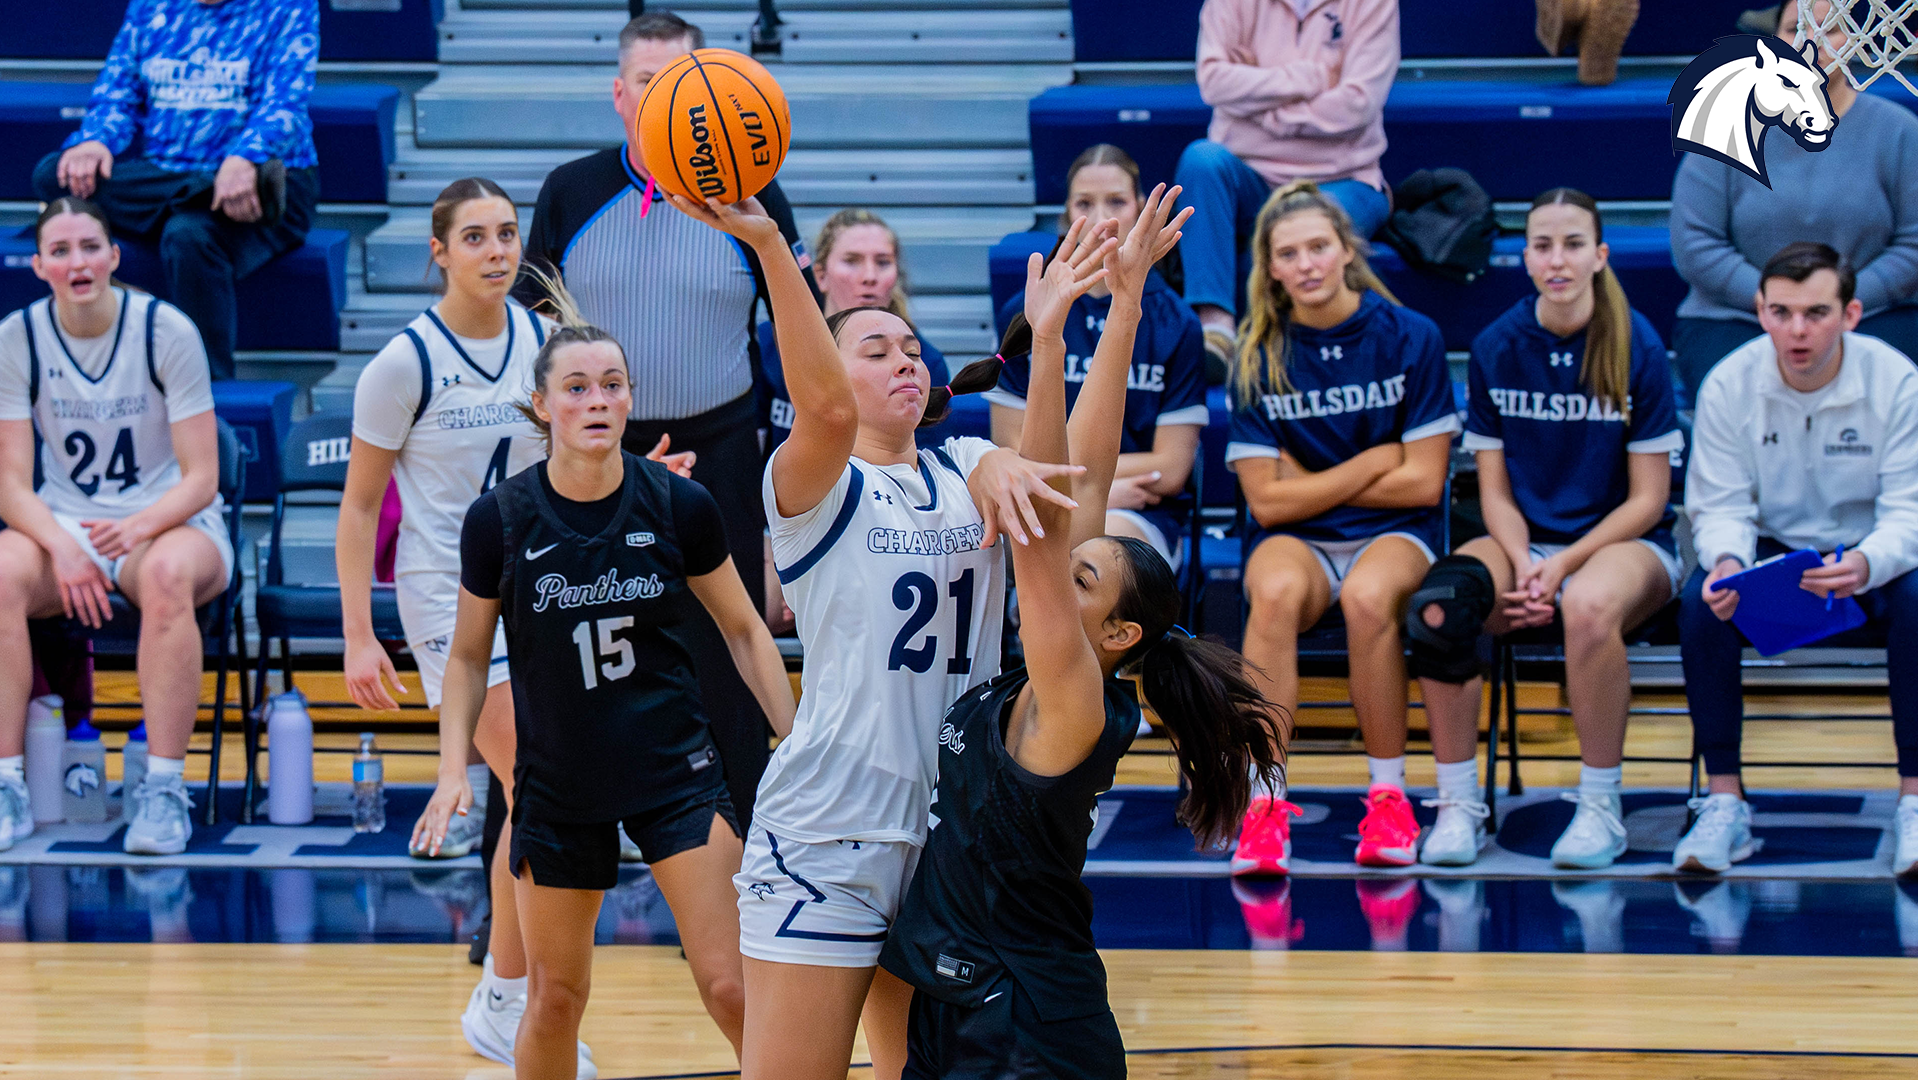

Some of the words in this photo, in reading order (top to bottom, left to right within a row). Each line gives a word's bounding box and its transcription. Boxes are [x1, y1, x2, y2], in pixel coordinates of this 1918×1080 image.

[689, 103, 727, 198] Wilson
[64, 426, 140, 497] 24
[533, 568, 664, 612] Panthers
[888, 567, 974, 675] 21
[572, 615, 636, 690] 15
[961, 966, 969, 977] M
